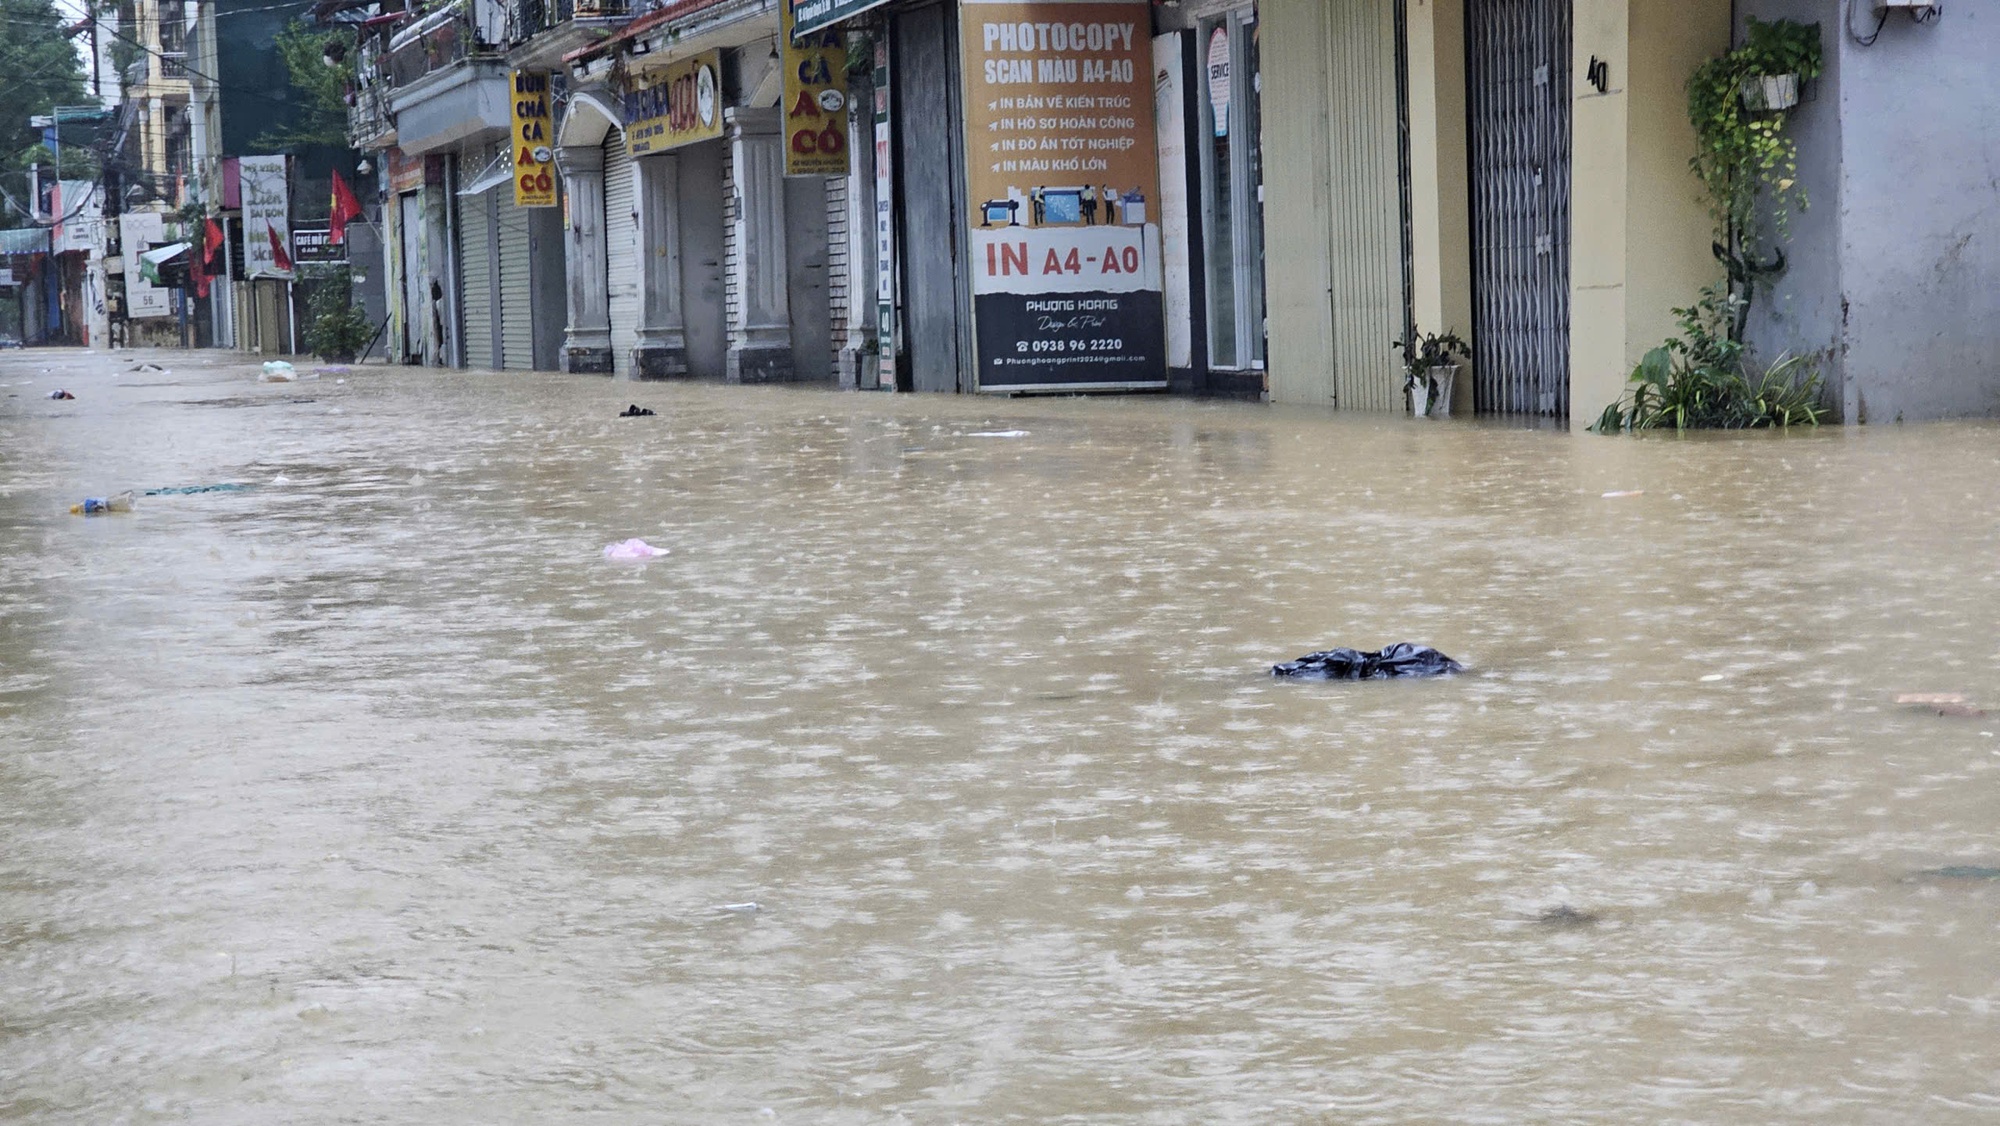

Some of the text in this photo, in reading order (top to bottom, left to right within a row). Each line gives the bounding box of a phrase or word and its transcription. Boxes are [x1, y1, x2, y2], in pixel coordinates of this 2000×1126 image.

[983, 22, 1135, 51] PHOTOCOPY
[985, 56, 1134, 84] SCAN MÀU A4-A0
[1586, 54, 1607, 93] 40
[1000, 97, 1013, 109] IN
[1097, 95, 1131, 108] TRÚC
[1001, 118, 1014, 129] IN
[1060, 115, 1096, 129] HOÀN
[1099, 116, 1135, 128] CÔNG
[792, 119, 845, 154] CÓ
[1002, 139, 1015, 151] IN
[1040, 136, 1057, 150] ÁN
[1003, 159, 1016, 171] IN
[1020, 158, 1049, 171] MÀU
[987, 242, 1029, 276] IN
[1042, 247, 1082, 275] A4
[1101, 246, 1139, 274] A0
[1032, 339, 1123, 352] 0938 96 2220
